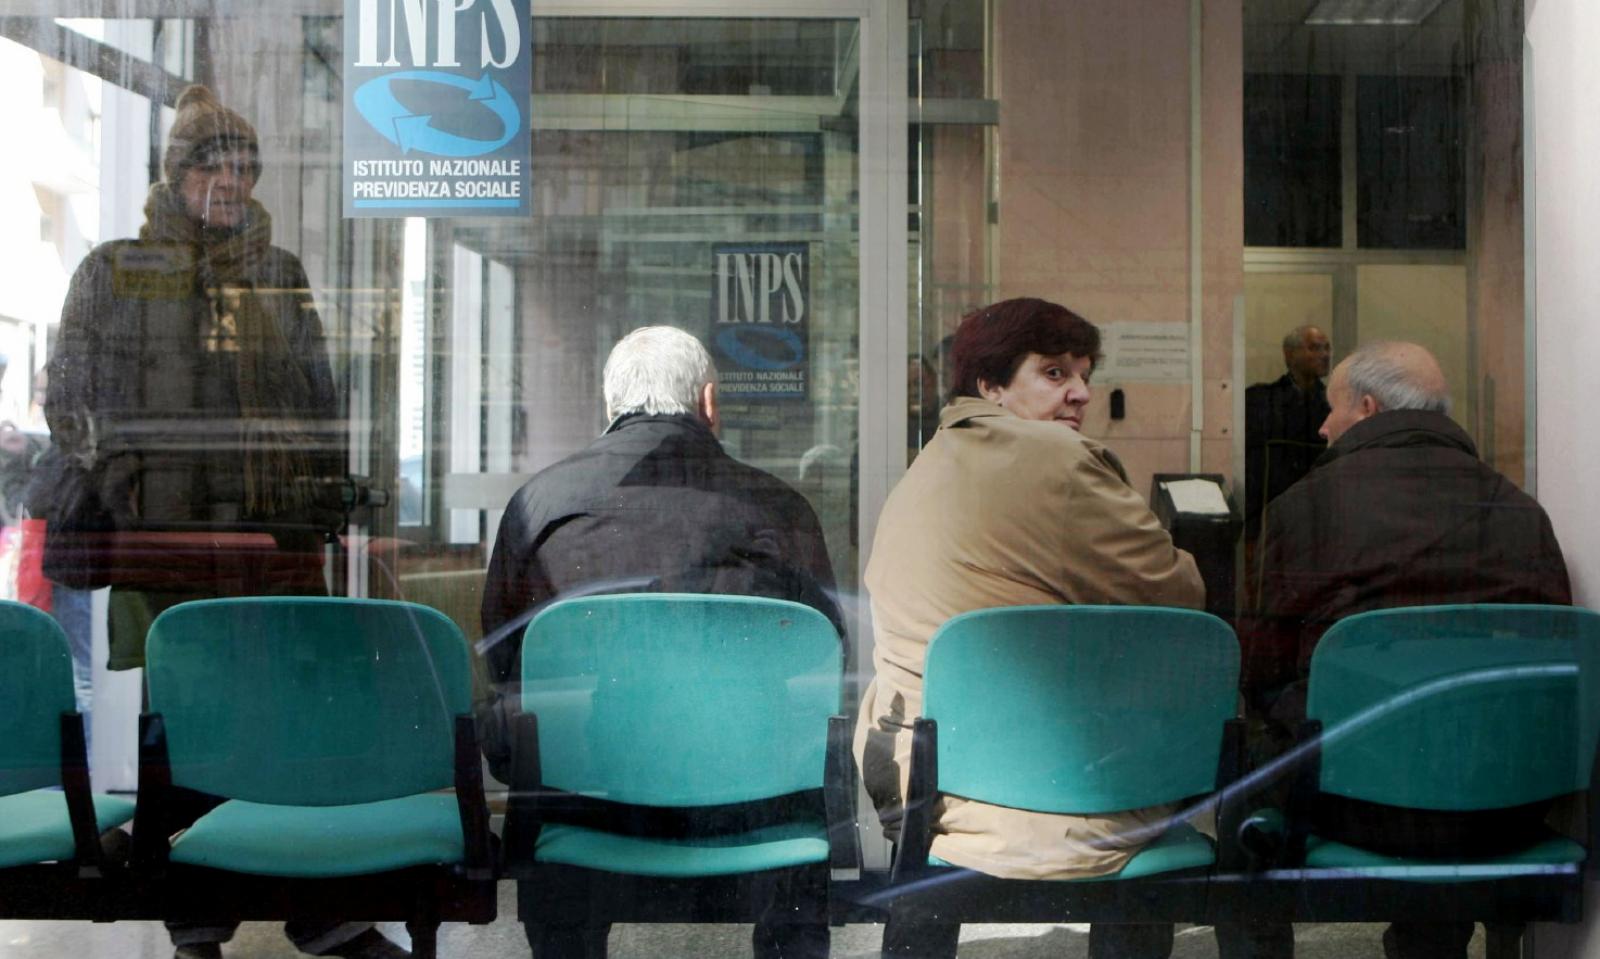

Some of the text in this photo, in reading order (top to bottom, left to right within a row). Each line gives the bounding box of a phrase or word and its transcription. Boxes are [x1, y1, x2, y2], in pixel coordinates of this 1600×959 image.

[353, 160, 521, 177] ISTITUTO NAZIONALE
[353, 181, 521, 198] PREVIDENZA SOCIALE
[716, 252, 804, 323] INPS
[719, 370, 804, 381] STITUTO NAZIONALE
[769, 382, 804, 393] SOCIALE
